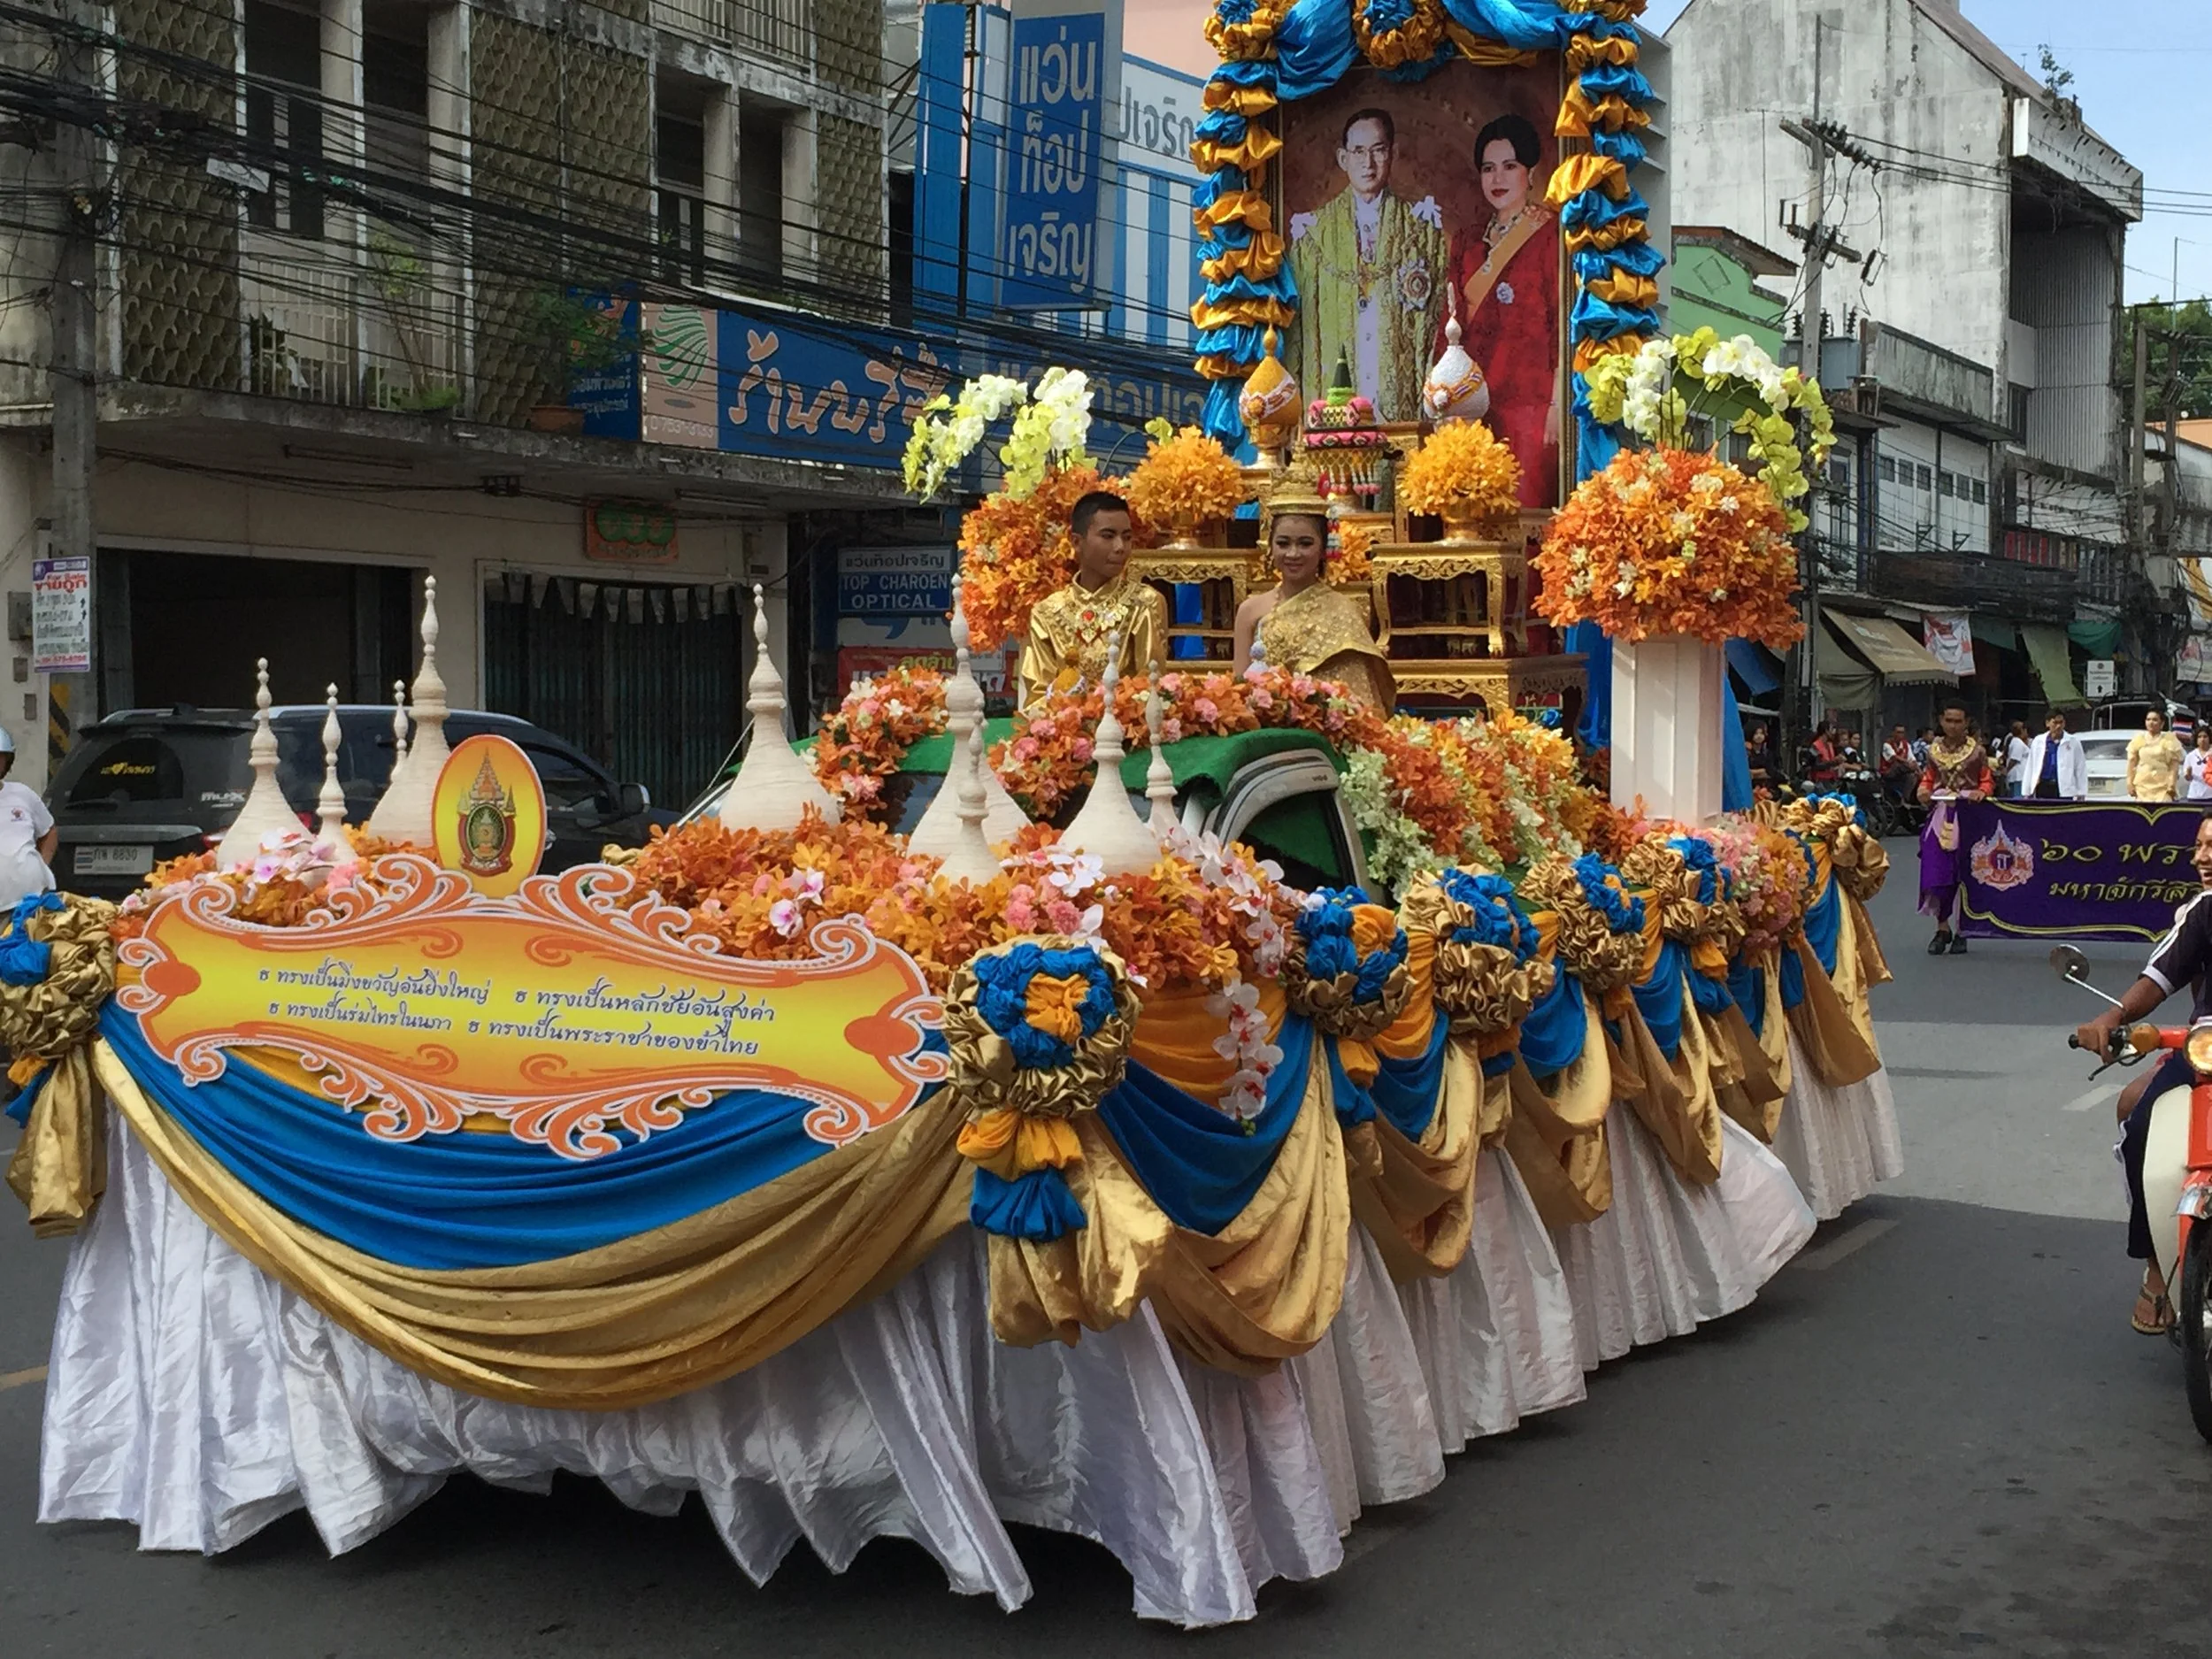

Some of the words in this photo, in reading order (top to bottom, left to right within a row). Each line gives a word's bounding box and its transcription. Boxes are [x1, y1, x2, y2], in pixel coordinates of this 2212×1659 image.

[1019, 25, 1096, 105] แว่น
[1020, 109, 1090, 194] ท็อป
[1008, 211, 1092, 294] เจริญ
[846, 552, 944, 568] แว่นท็อปเจริญ
[843, 574, 869, 590] TOP
[879, 573, 948, 590] CHAROEN
[852, 594, 935, 610] OPTICAL
[259, 969, 270, 981] ธ
[515, 989, 527, 1002] ธ
[269, 1002, 280, 1015] ธ
[468, 1020, 480, 1033] ธ
